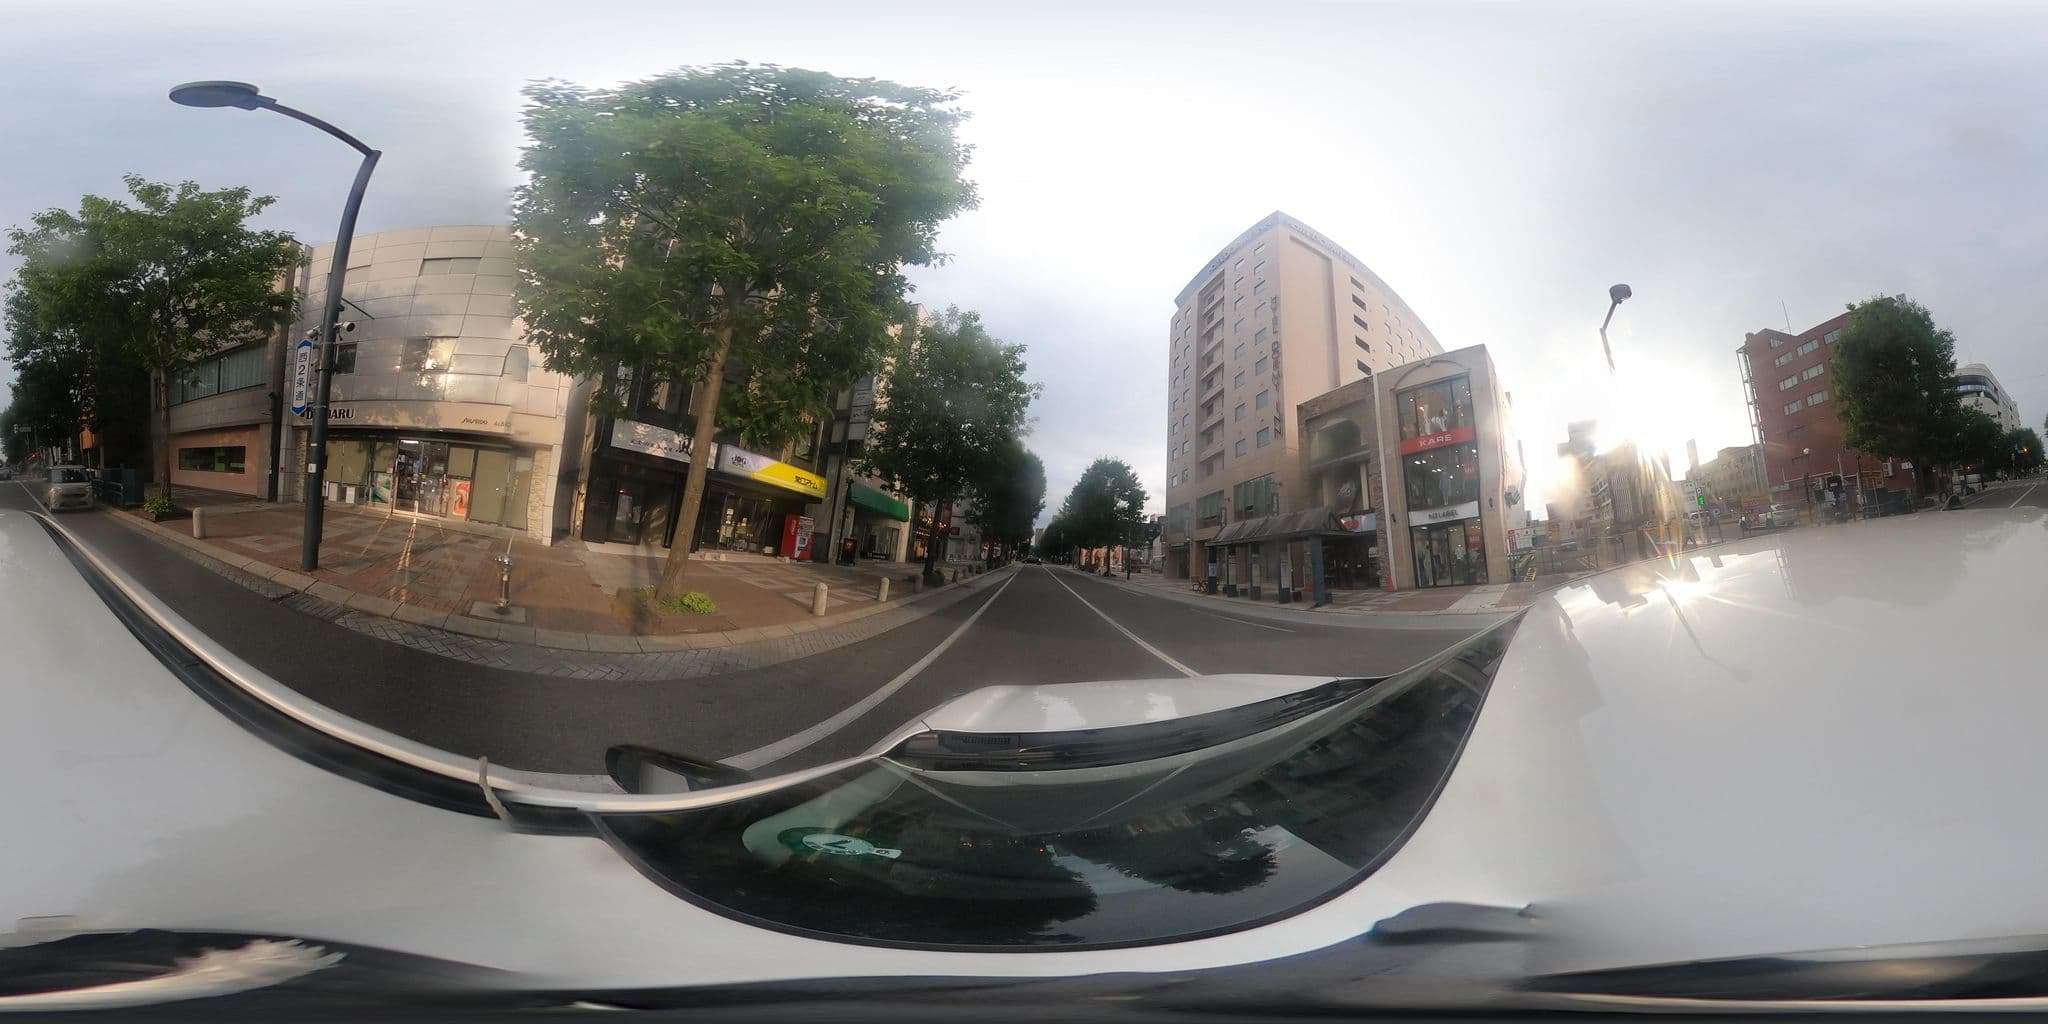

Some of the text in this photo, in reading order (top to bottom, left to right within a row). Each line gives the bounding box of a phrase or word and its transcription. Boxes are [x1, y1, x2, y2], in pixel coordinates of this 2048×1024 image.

[296, 352, 308, 401] 西2条通
[305, 408, 354, 420] DARU
[1419, 434, 1453, 447] KARE
